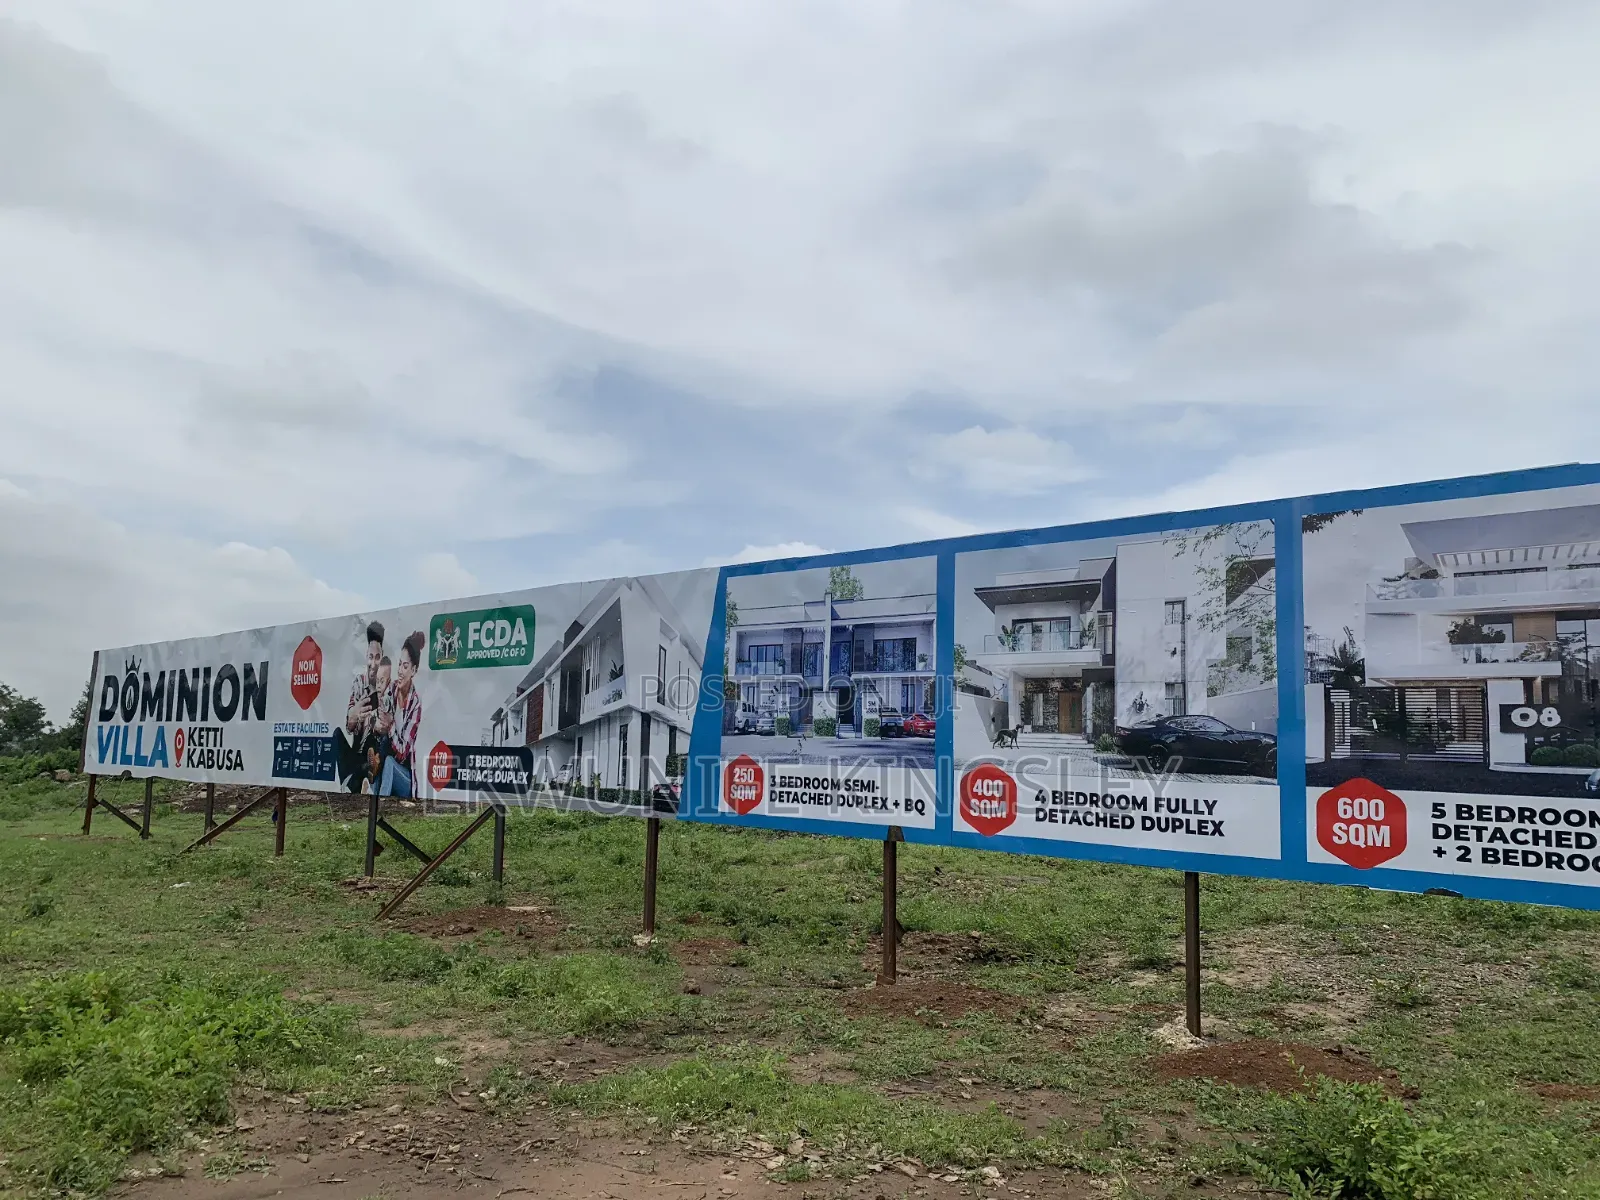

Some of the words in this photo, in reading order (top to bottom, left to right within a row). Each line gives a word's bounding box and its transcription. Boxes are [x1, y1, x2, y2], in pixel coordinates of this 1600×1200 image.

[467, 617, 528, 648] FCDA
[466, 648, 501, 660] APPROVED
[510, 647, 519, 657] OF
[298, 660, 315, 672] NOW
[293, 673, 319, 686] SELLING
[98, 660, 270, 723] DOMINION
[187, 727, 224, 748] KETTI
[273, 722, 296, 734] ESTATE
[297, 722, 330, 734] FACILITIES
[97, 725, 169, 768] VILLA
[186, 748, 245, 772] KABUSA
[475, 754, 519, 769] BEDROOM
[456, 768, 494, 783] TERRACE
[494, 770, 530, 785] DUPLEX
[732, 767, 755, 783] 250
[769, 774, 777, 788] 3
[778, 775, 842, 792] BEDROOM
[843, 778, 880, 793] SEMI-
[729, 784, 756, 802] SQM
[972, 778, 1004, 798] 400
[769, 790, 834, 807] DETACHED
[838, 794, 890, 811] DUPLEX
[904, 798, 926, 817] BQ
[969, 798, 1008, 819] SQM
[1034, 788, 1046, 805] 4
[1051, 790, 1148, 812] BEDROOM
[1154, 796, 1219, 816] FULLY
[1336, 797, 1385, 821] 600
[1430, 802, 1447, 820] 5
[1034, 807, 1135, 830] DETACHED
[1141, 816, 1226, 837] DUPLEX
[1332, 821, 1391, 849] SQM
[1431, 822, 1598, 850] DETACHED
[1432, 846, 1447, 859] +
[1455, 845, 1473, 863] 2
